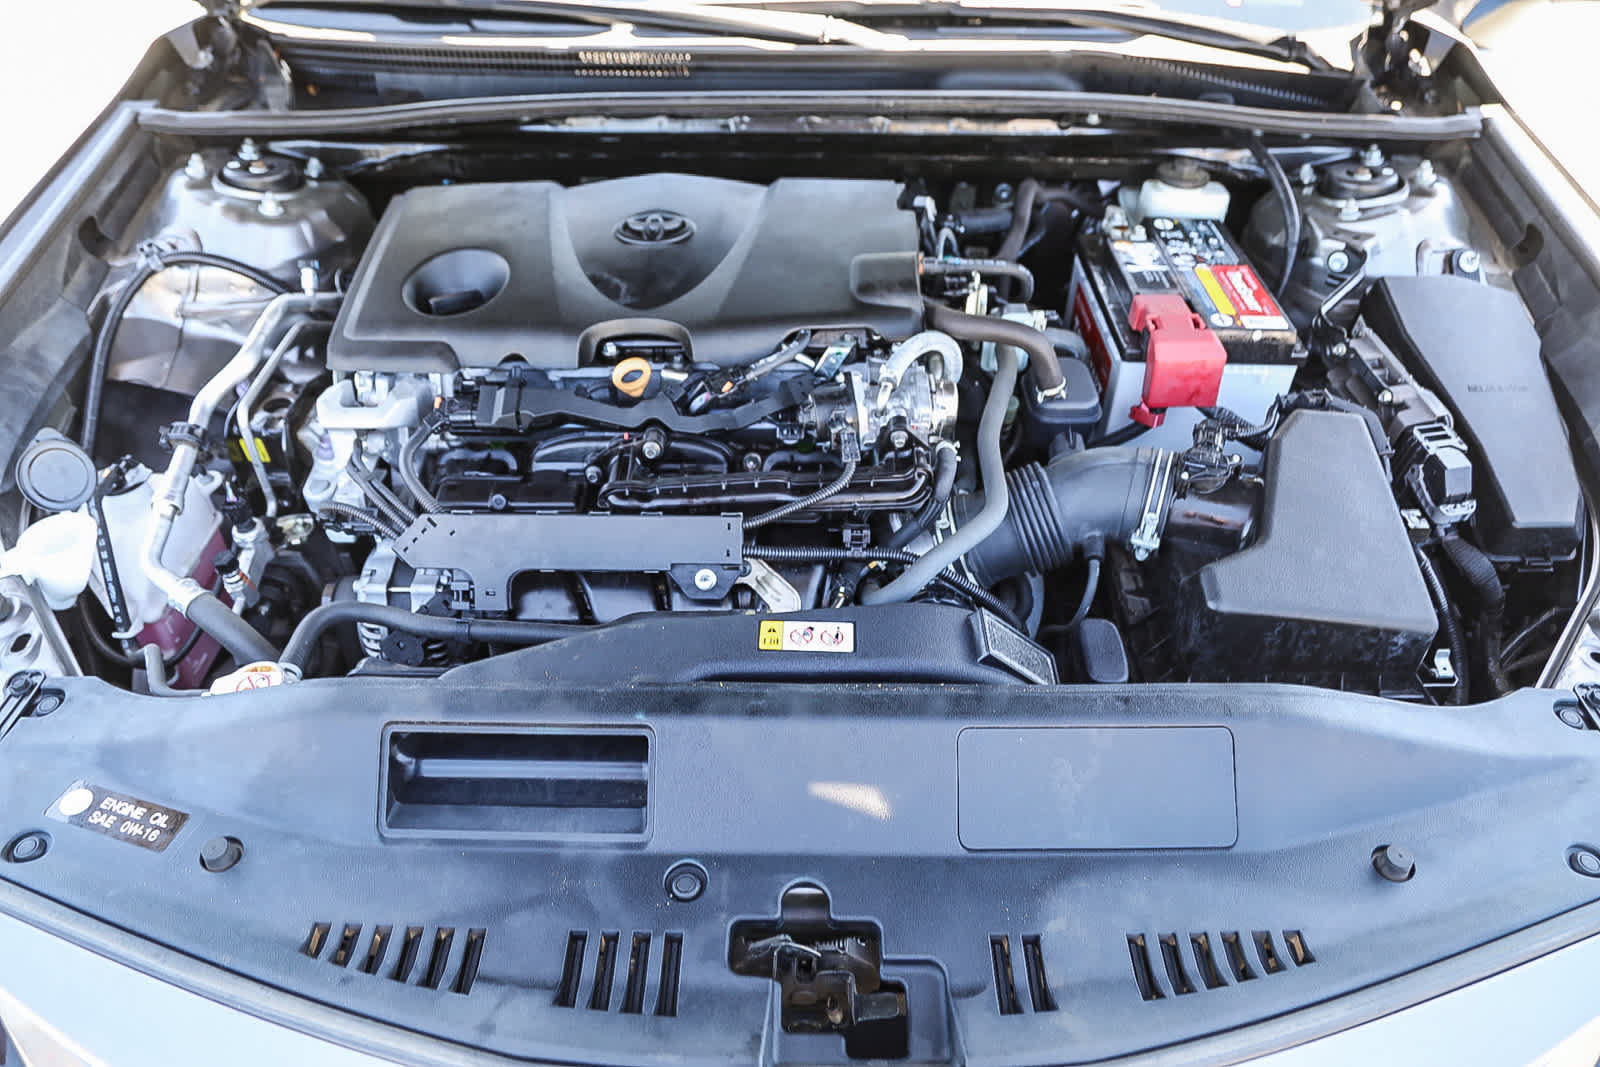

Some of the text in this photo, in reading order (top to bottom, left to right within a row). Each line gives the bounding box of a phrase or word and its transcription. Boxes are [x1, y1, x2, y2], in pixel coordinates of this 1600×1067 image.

[88, 810, 161, 842] SAE 0W-16
[100, 797, 169, 829] ENGINE OIL
